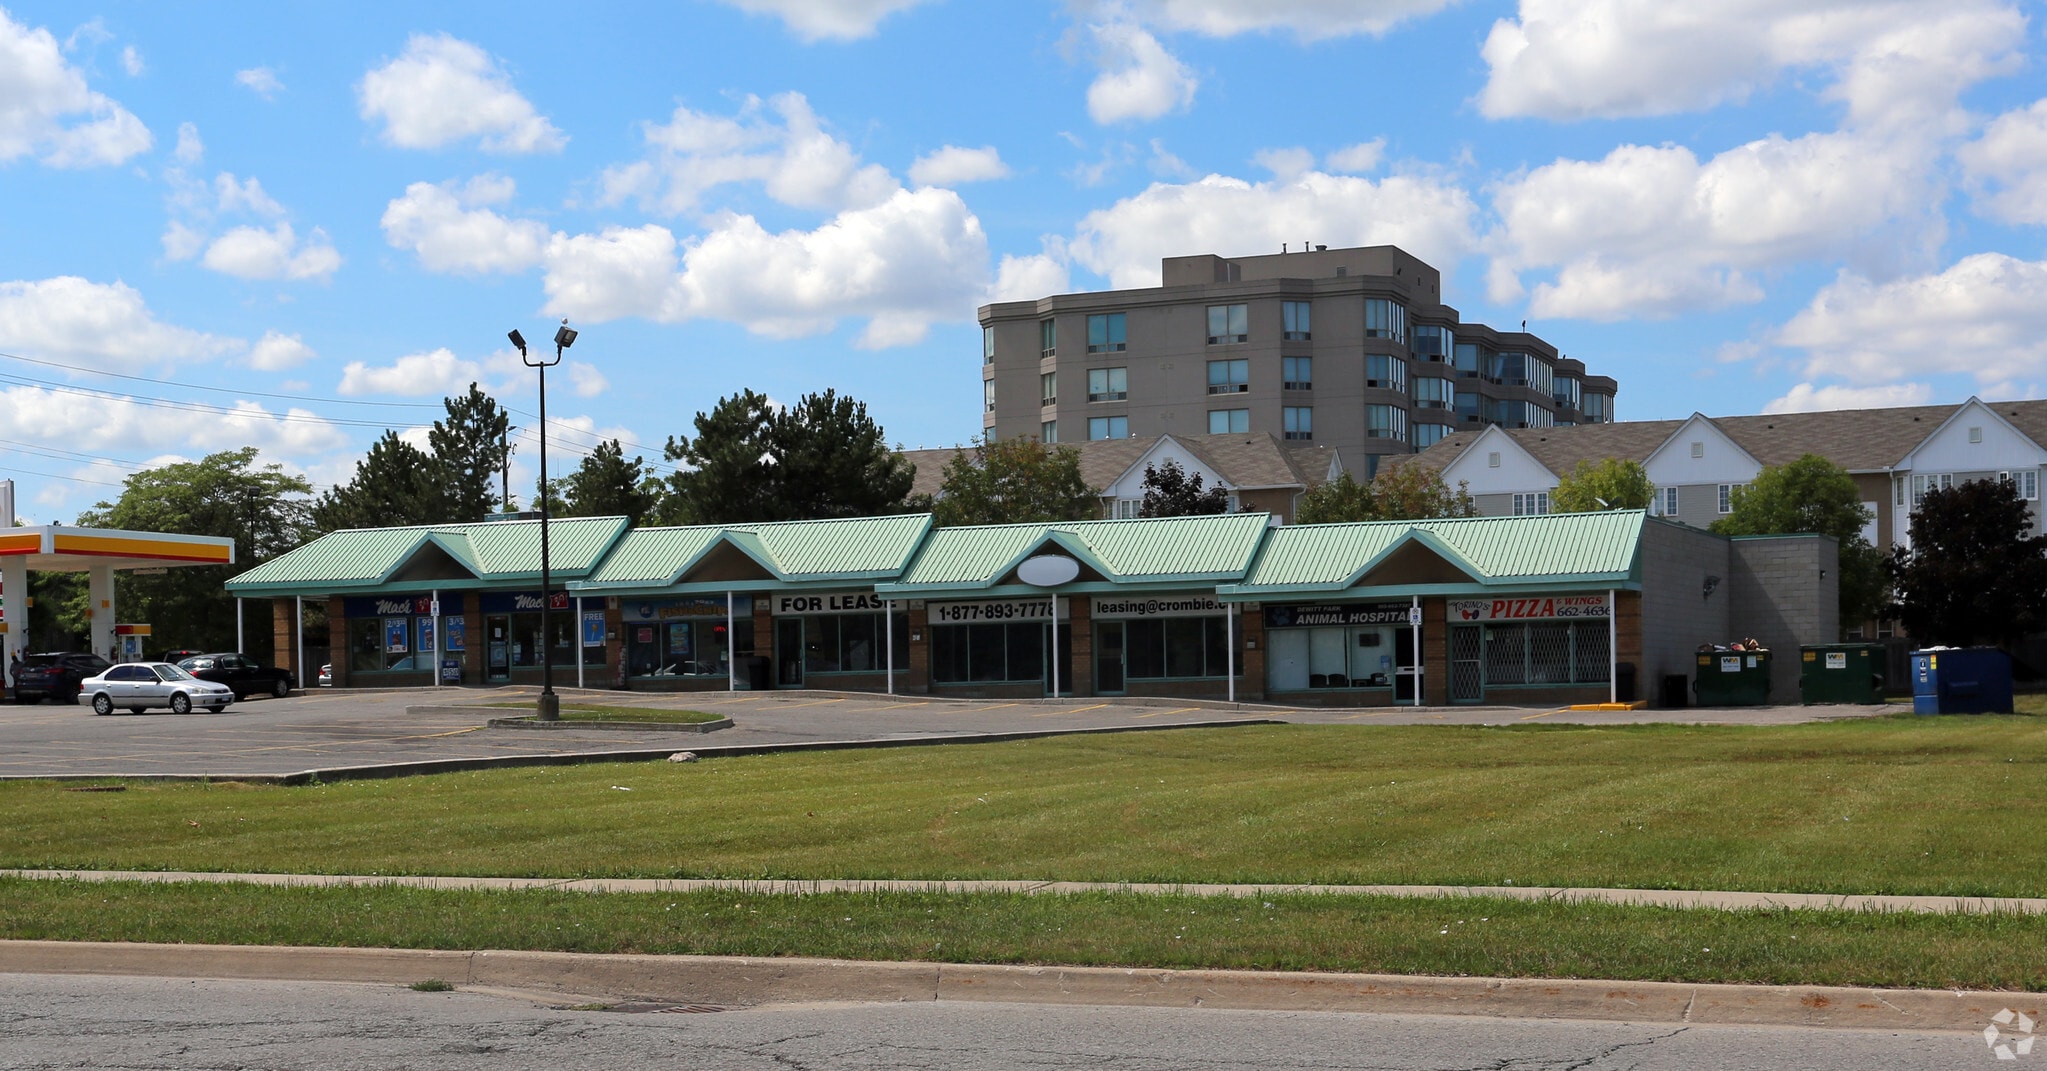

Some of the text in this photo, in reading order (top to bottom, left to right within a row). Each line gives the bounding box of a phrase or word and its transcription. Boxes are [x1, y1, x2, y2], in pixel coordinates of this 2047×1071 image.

[376, 599, 412, 614] Mac's
[515, 594, 545, 609] Mac
[781, 597, 822, 612] FOR
[1097, 598, 1235, 615] leasing@crombie.c
[1490, 598, 1554, 618] PIZZA
[1565, 596, 1602, 605] WINGS
[1296, 614, 1345, 624] ANIMAL
